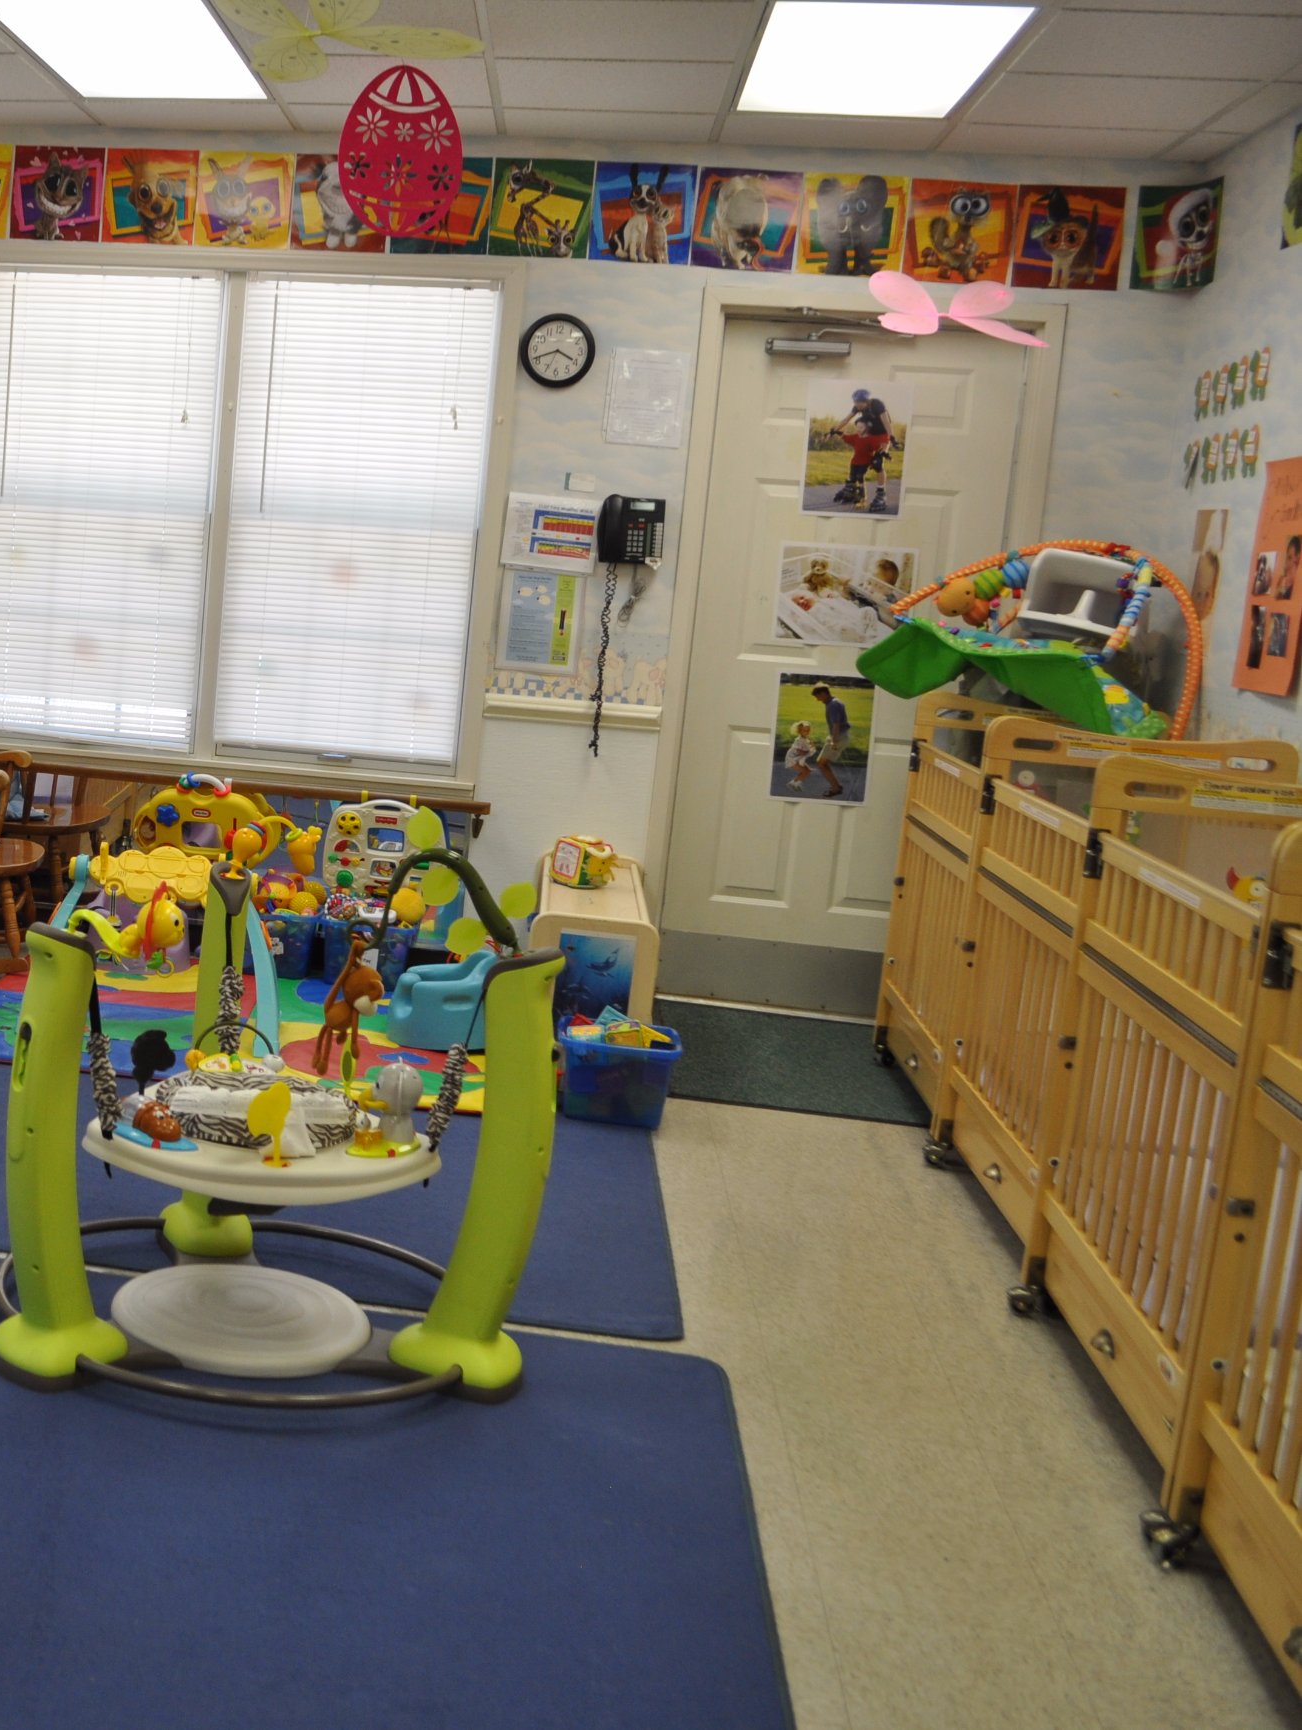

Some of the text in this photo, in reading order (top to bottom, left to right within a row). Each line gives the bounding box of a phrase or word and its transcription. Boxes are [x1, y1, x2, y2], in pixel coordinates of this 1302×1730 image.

[546, 327, 553, 337] 11
[556, 324, 564, 334] 12
[536, 335, 546, 344] 10
[575, 337, 581, 345] 2
[532, 344, 538, 354] 9
[578, 347, 584, 356] 3
[534, 356, 541, 366] 8
[572, 358, 578, 367] 4
[544, 363, 550, 373] 7
[553, 368, 559, 377] 6
[564, 364, 570, 374] 5
